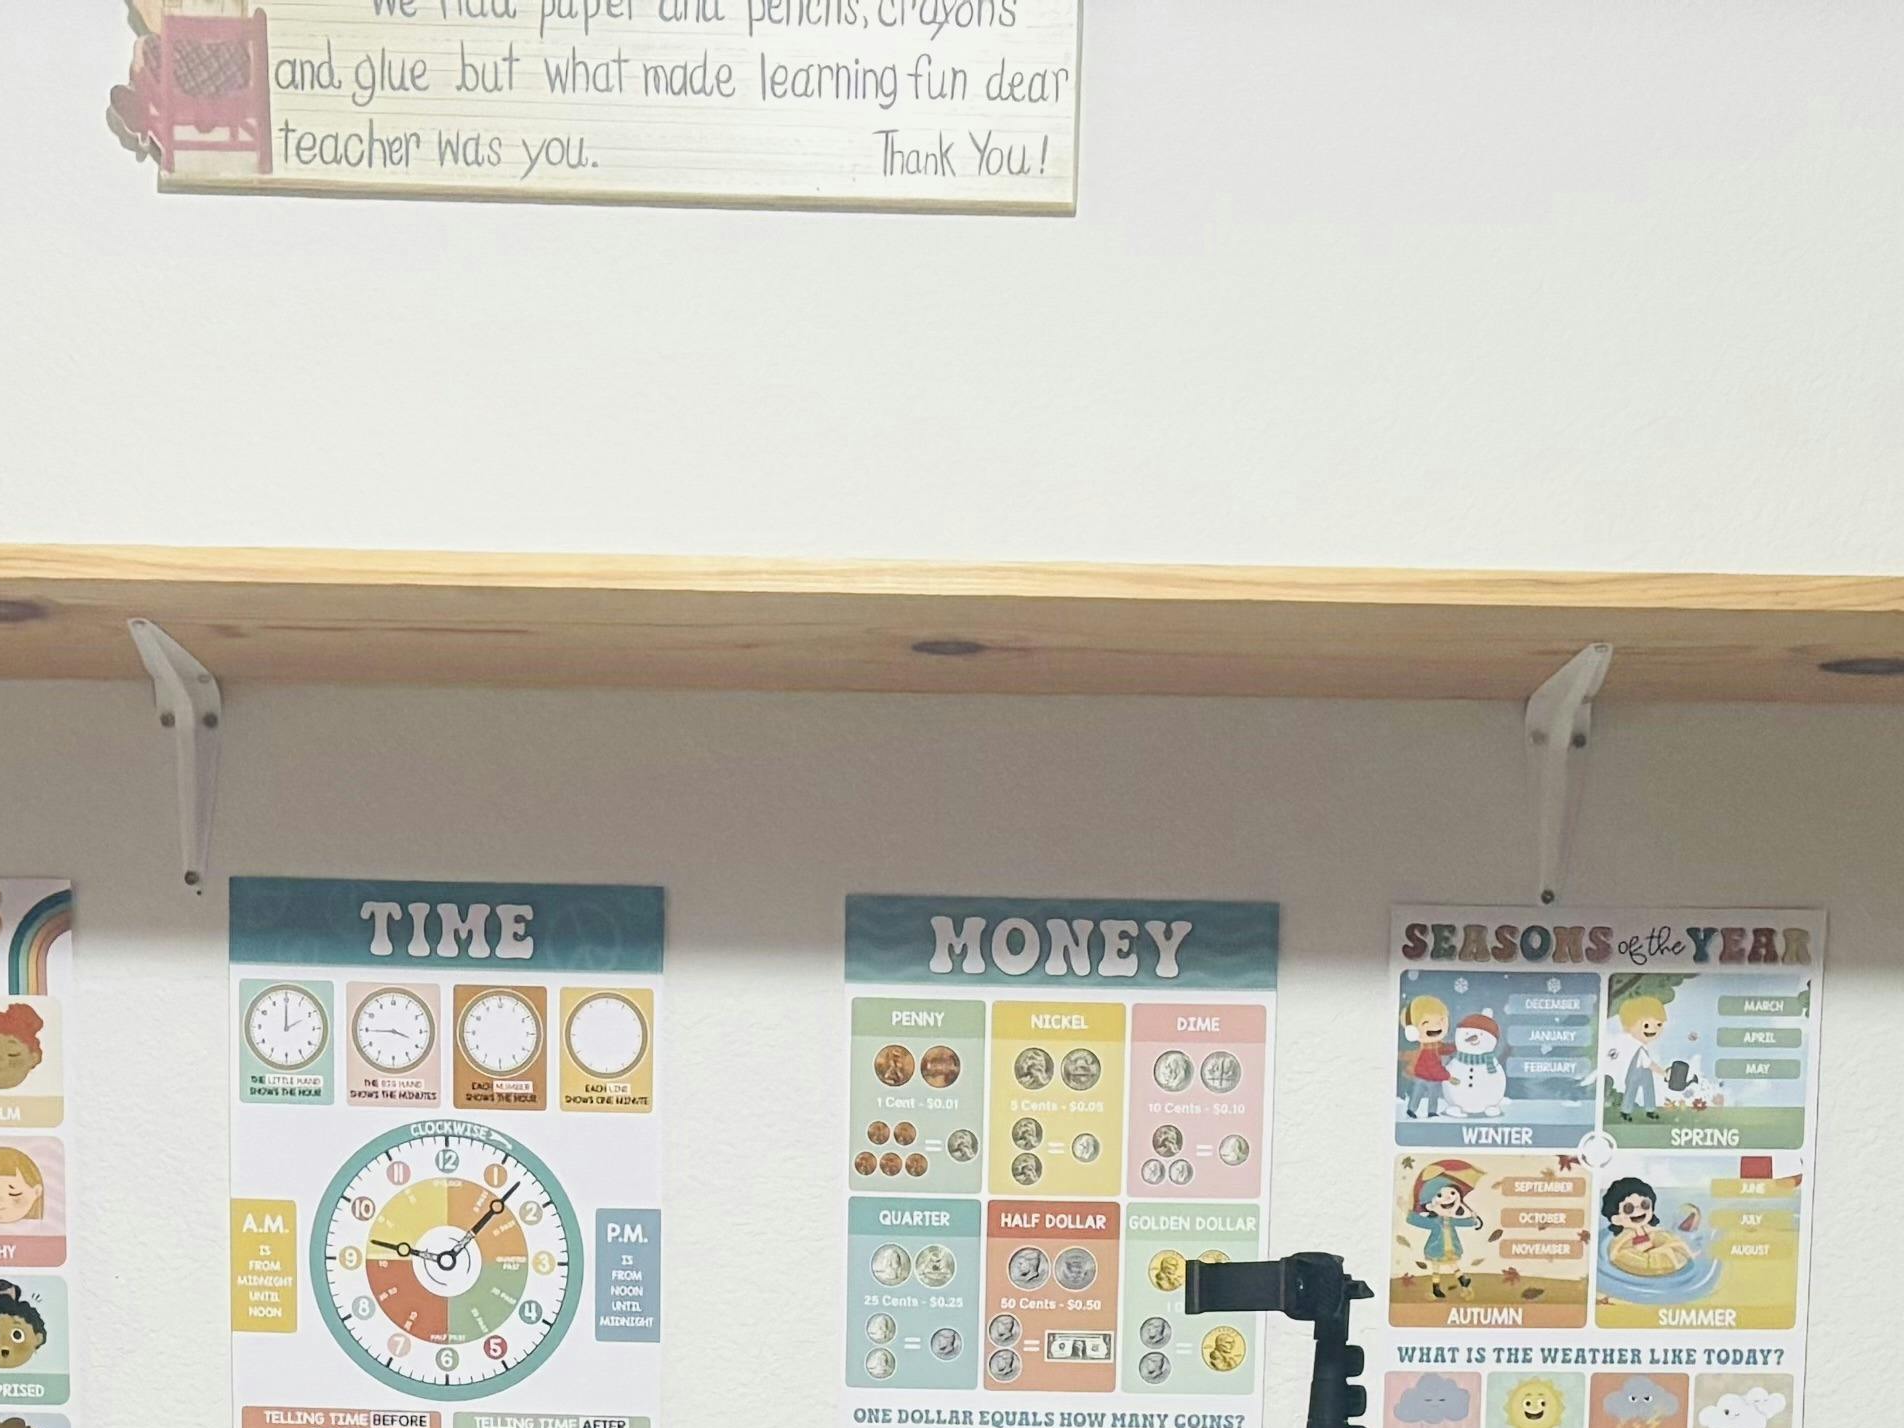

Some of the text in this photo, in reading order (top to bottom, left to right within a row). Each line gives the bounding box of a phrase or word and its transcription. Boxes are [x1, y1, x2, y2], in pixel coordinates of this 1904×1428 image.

[275, 38, 1069, 110] and glue but what made learning fun dear
[278, 118, 599, 180] teacher was you.
[872, 129, 1049, 177] Thank You!
[360, 901, 535, 959] TIME
[928, 916, 1193, 977] MONEY
[1402, 924, 1811, 965] SEASONS of the YEAR
[891, 1011, 944, 1027] PENNY
[1031, 1015, 1088, 1030] NICKEL
[410, 1121, 488, 1139] CLOCKWISE
[1462, 1127, 1533, 1145] WINTER
[1671, 1129, 1740, 1147] SPRING
[242, 1214, 288, 1234] A.M.
[606, 1224, 648, 1242] P.M.
[1447, 1308, 1523, 1325] AUTUMN
[1658, 1309, 1736, 1326] SUMMER
[1397, 1345, 1784, 1366] WHAT IS THE WEATHER LIKE TODAY?
[264, 1411, 427, 1428] TELLING TIME BEFORE
[853, 1408, 892, 1424] ONE
[897, 1409, 973, 1426] DOLLAR
[978, 1410, 1055, 1428] EQUALS
[1060, 1412, 1106, 1428] HOW
[1110, 1413, 1168, 1428] MANY
